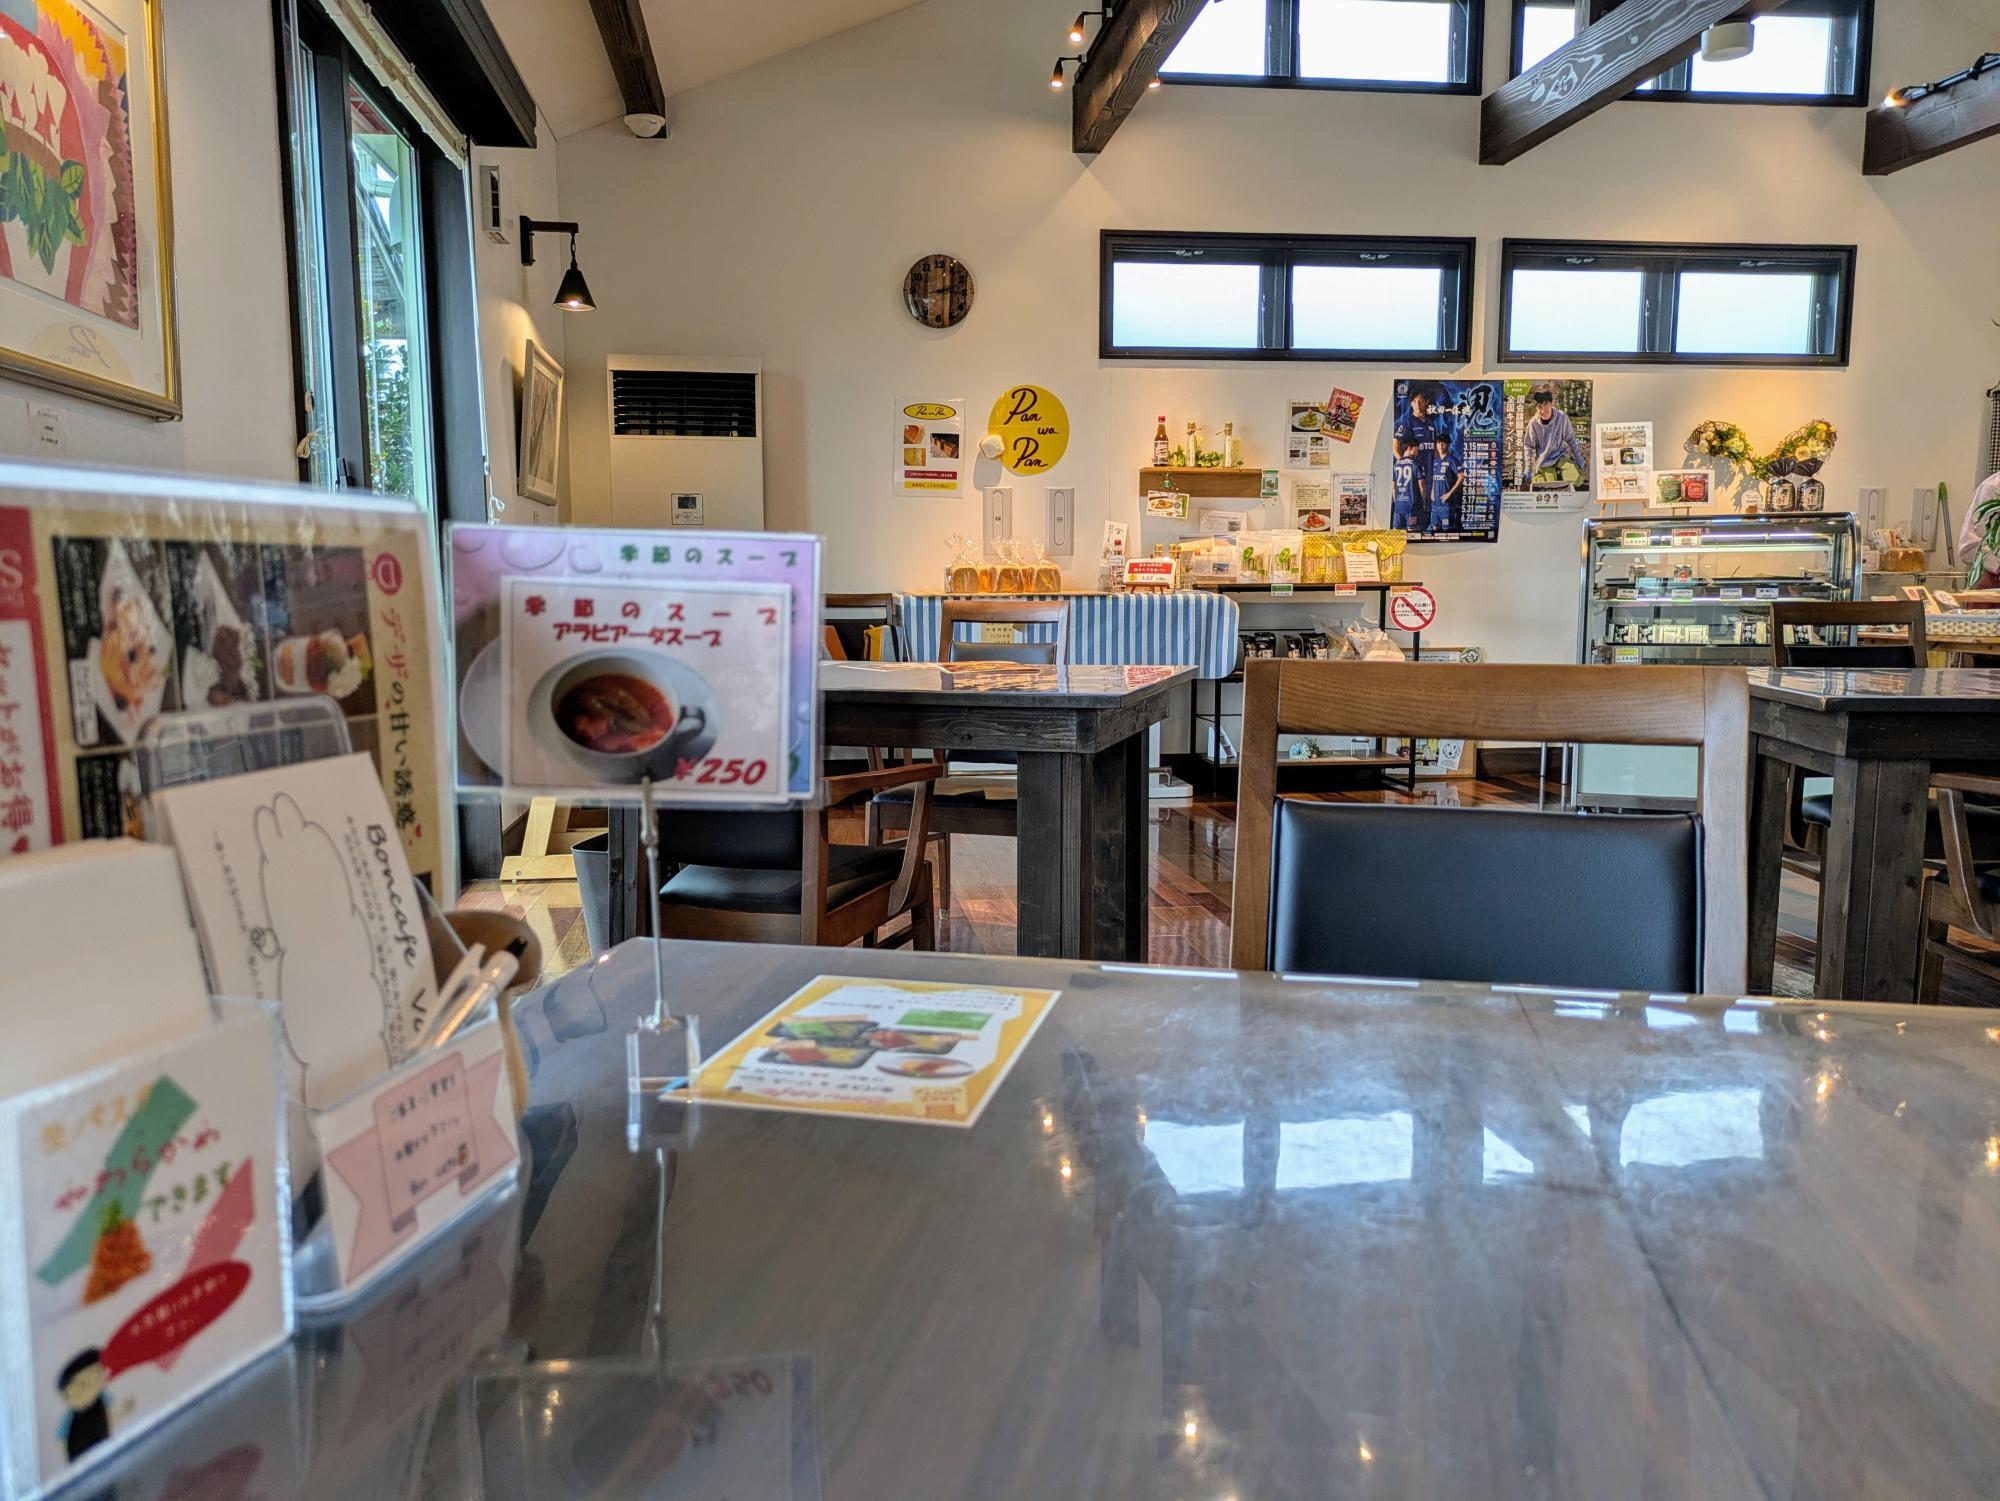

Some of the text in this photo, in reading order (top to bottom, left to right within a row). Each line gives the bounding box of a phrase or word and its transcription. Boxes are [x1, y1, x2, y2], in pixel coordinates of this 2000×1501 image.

[1003, 387, 1043, 425] Pan
[1036, 427, 1059, 435] wa
[1505, 395, 1515, 459] 全国キャンペーン
[1012, 436, 1049, 469] Pan
[1395, 466, 1412, 487] 29
[620, 544, 798, 568] 季節のスープ
[525, 595, 778, 626] 季節のスープ
[673, 757, 768, 786] ¥250
